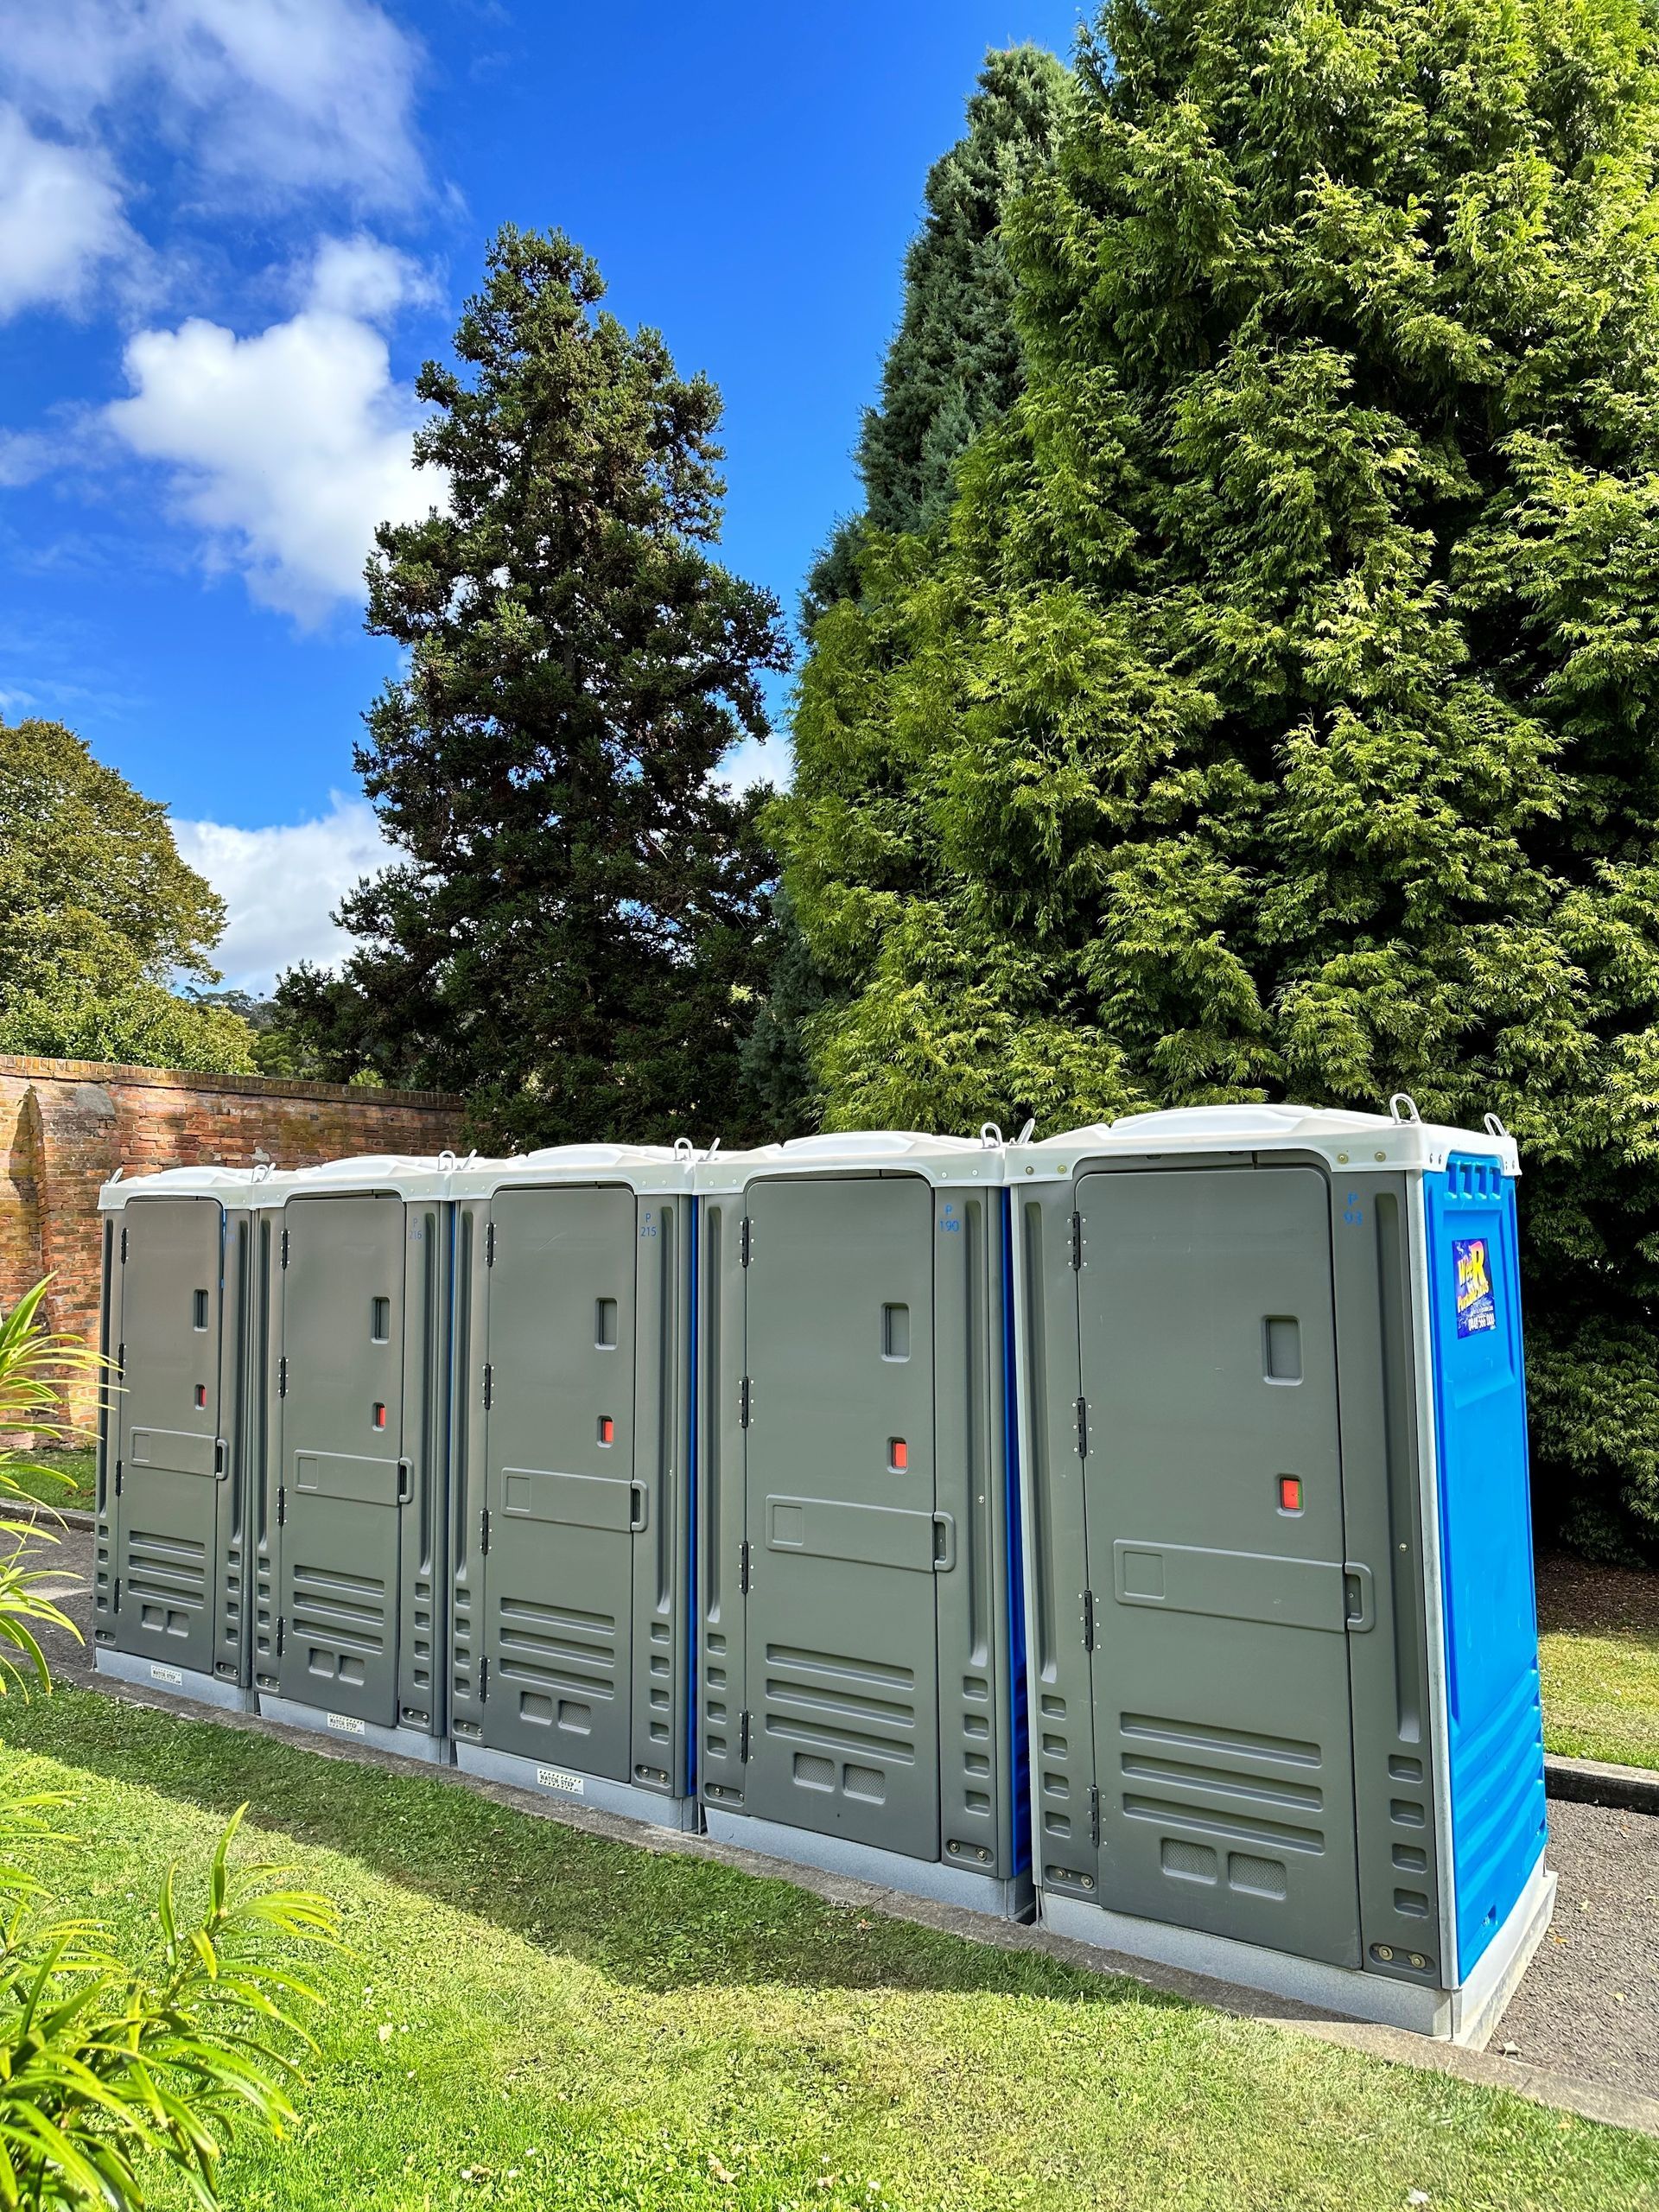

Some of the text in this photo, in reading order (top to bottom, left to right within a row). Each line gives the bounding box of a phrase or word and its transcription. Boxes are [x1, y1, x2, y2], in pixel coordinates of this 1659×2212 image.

[1347, 1193, 1358, 1207] P
[945, 1204, 953, 1215] P
[413, 1217, 418, 1228] P
[645, 1212, 652, 1223] P
[939, 1219, 960, 1232] 190
[408, 1230, 423, 1240] 216
[640, 1226, 657, 1237] 215
[1469, 1241, 1486, 1288] R
[540, 1775, 559, 1783] WATCH
